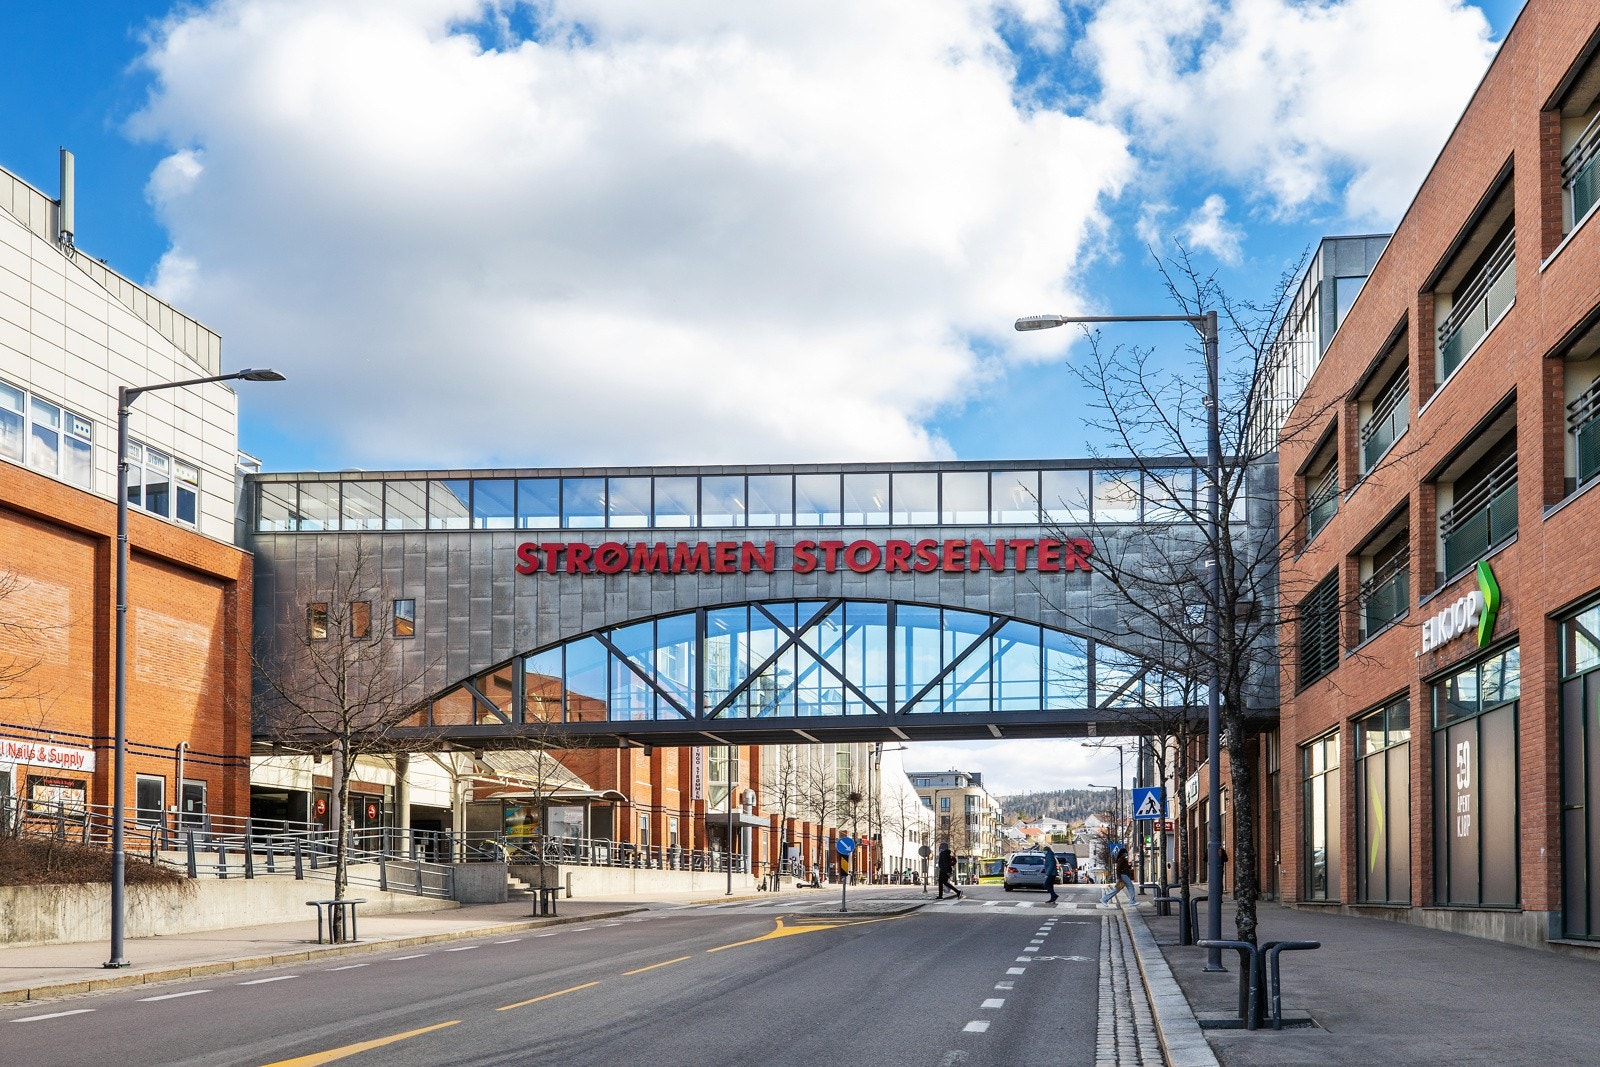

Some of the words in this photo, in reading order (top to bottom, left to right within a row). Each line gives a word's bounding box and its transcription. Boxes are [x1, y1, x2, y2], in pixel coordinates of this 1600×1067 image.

[515, 541, 775, 575] STRØMMEN
[792, 537, 1093, 573] STORSENTER
[1422, 590, 1484, 654] ELKJØP
[8, 743, 36, 759] Nails
[39, 746, 47, 761] &
[50, 748, 85, 767] Supply
[1456, 740, 1471, 790] 50
[1457, 792, 1471, 814] ÅPENT
[1456, 814, 1471, 838] KJØP
